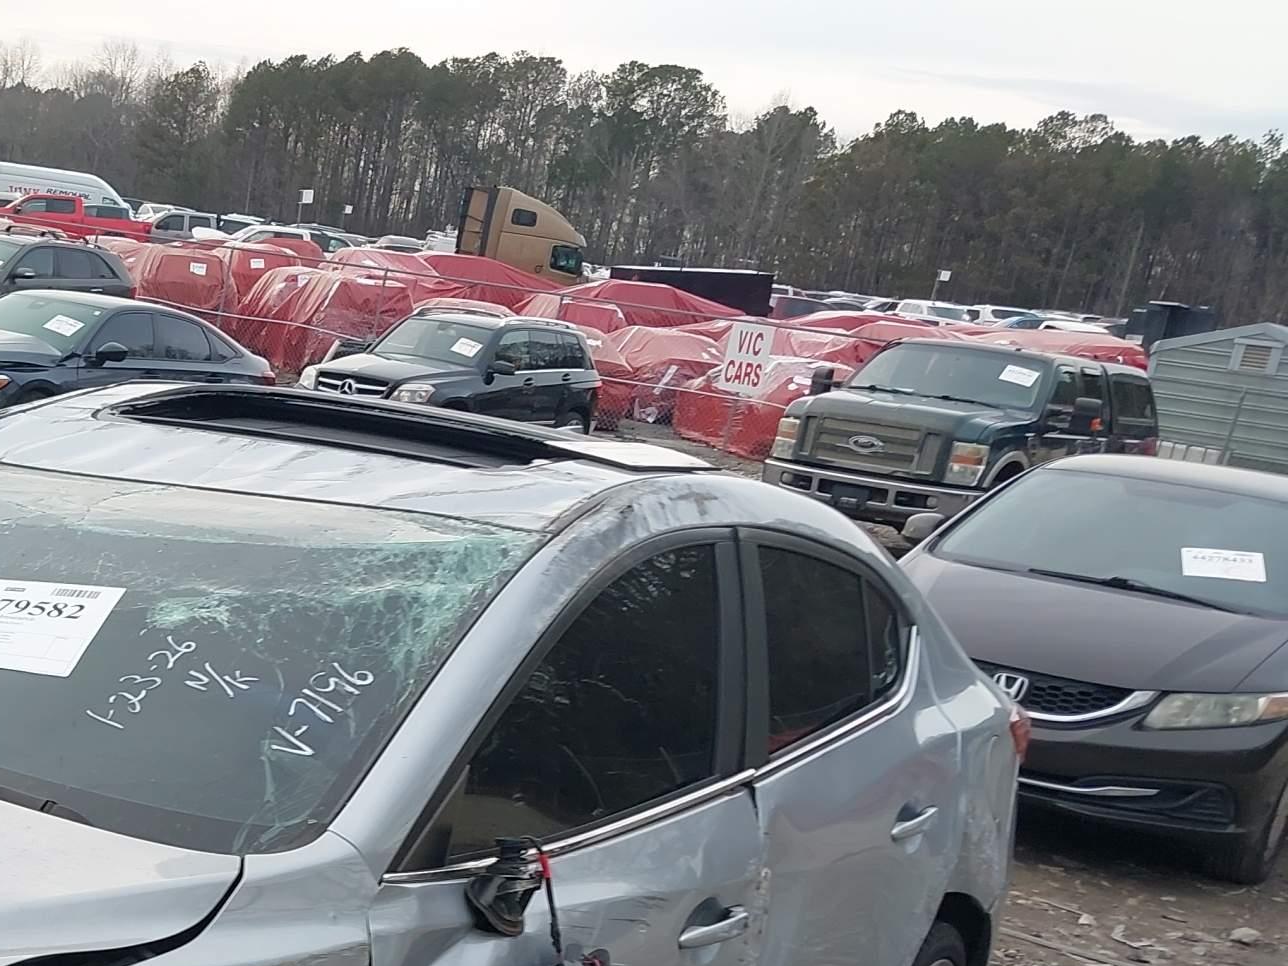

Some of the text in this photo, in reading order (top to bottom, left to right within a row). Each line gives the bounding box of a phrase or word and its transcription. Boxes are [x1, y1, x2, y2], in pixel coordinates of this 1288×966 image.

[738, 330, 764, 356] VIC
[724, 360, 762, 387] CARS
[184, 662, 261, 698] N/K
